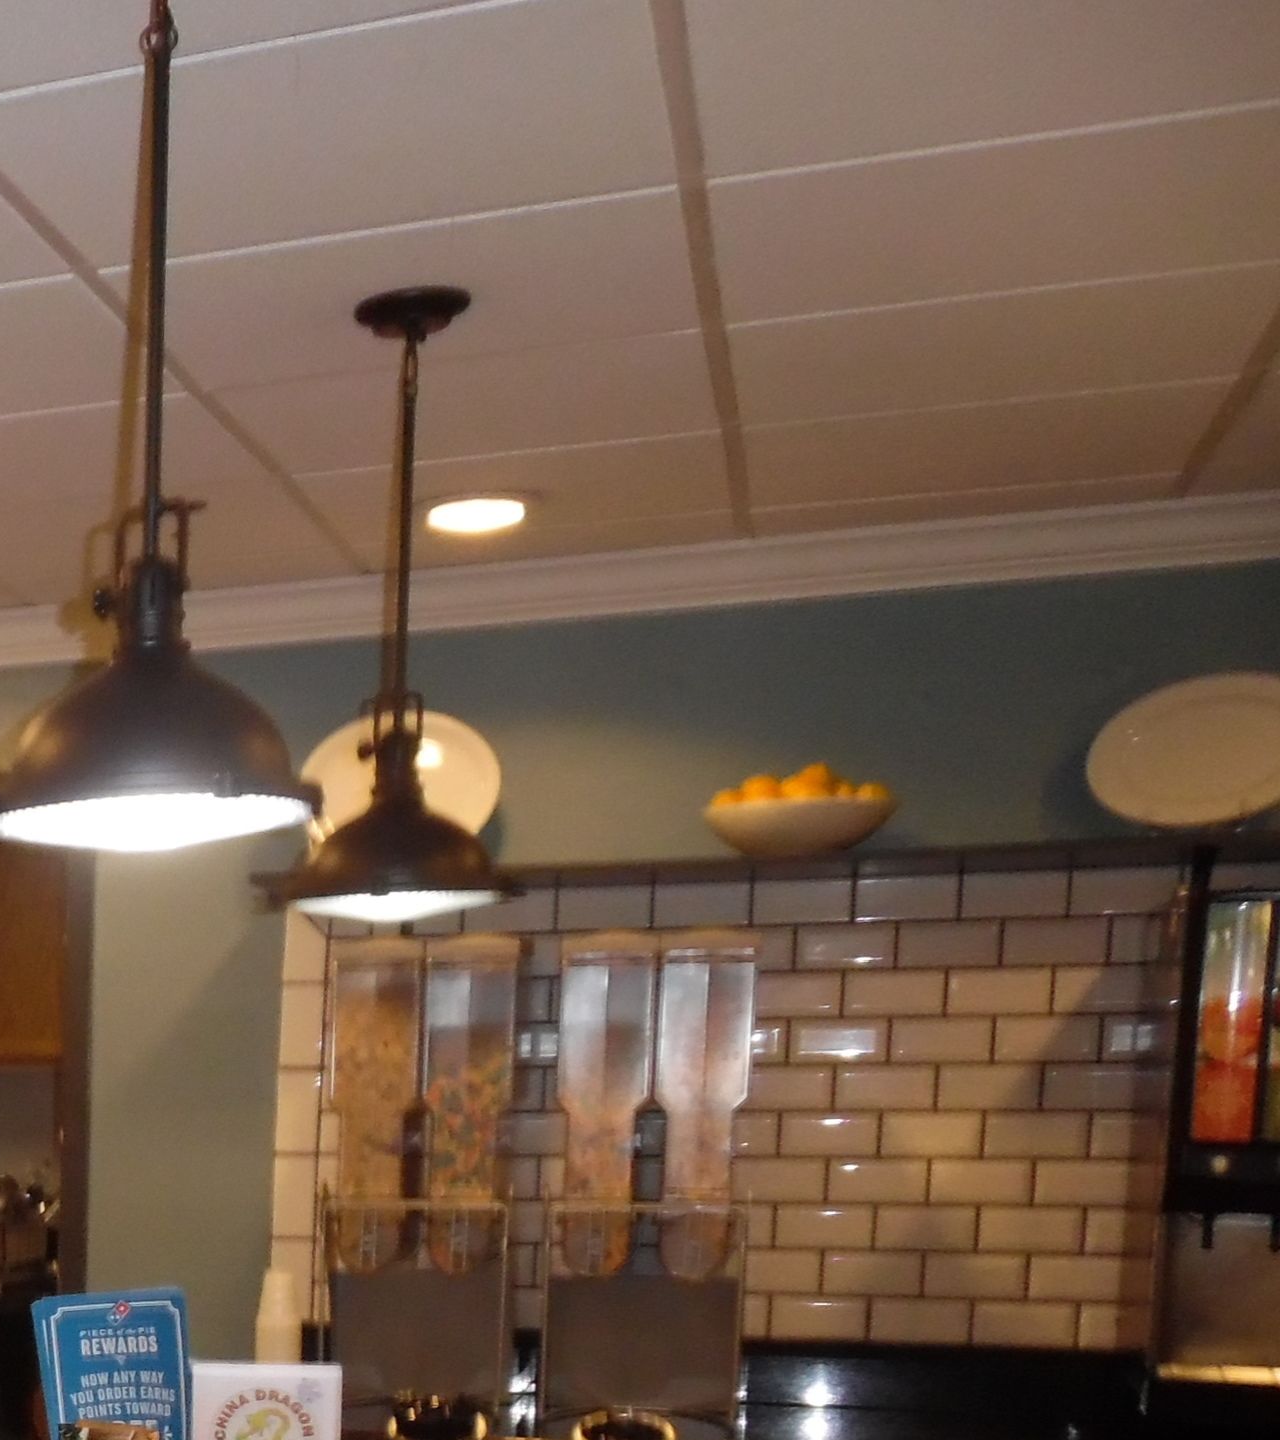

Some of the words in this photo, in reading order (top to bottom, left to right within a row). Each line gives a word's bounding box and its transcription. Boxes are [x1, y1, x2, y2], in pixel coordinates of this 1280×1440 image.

[80, 1335, 158, 1356] REWARDS
[81, 1372, 109, 1388] NOW
[113, 1370, 137, 1384] ANY
[140, 1370, 164, 1384] WAY
[70, 1390, 94, 1406] YOU
[97, 1386, 136, 1401] ORDER
[140, 1386, 175, 1402] EARNS
[78, 1403, 122, 1420] POINTS
[124, 1402, 171, 1417] TOWARD
[214, 1394, 250, 1440] CHINA
[255, 1388, 315, 1438] DRAGON
